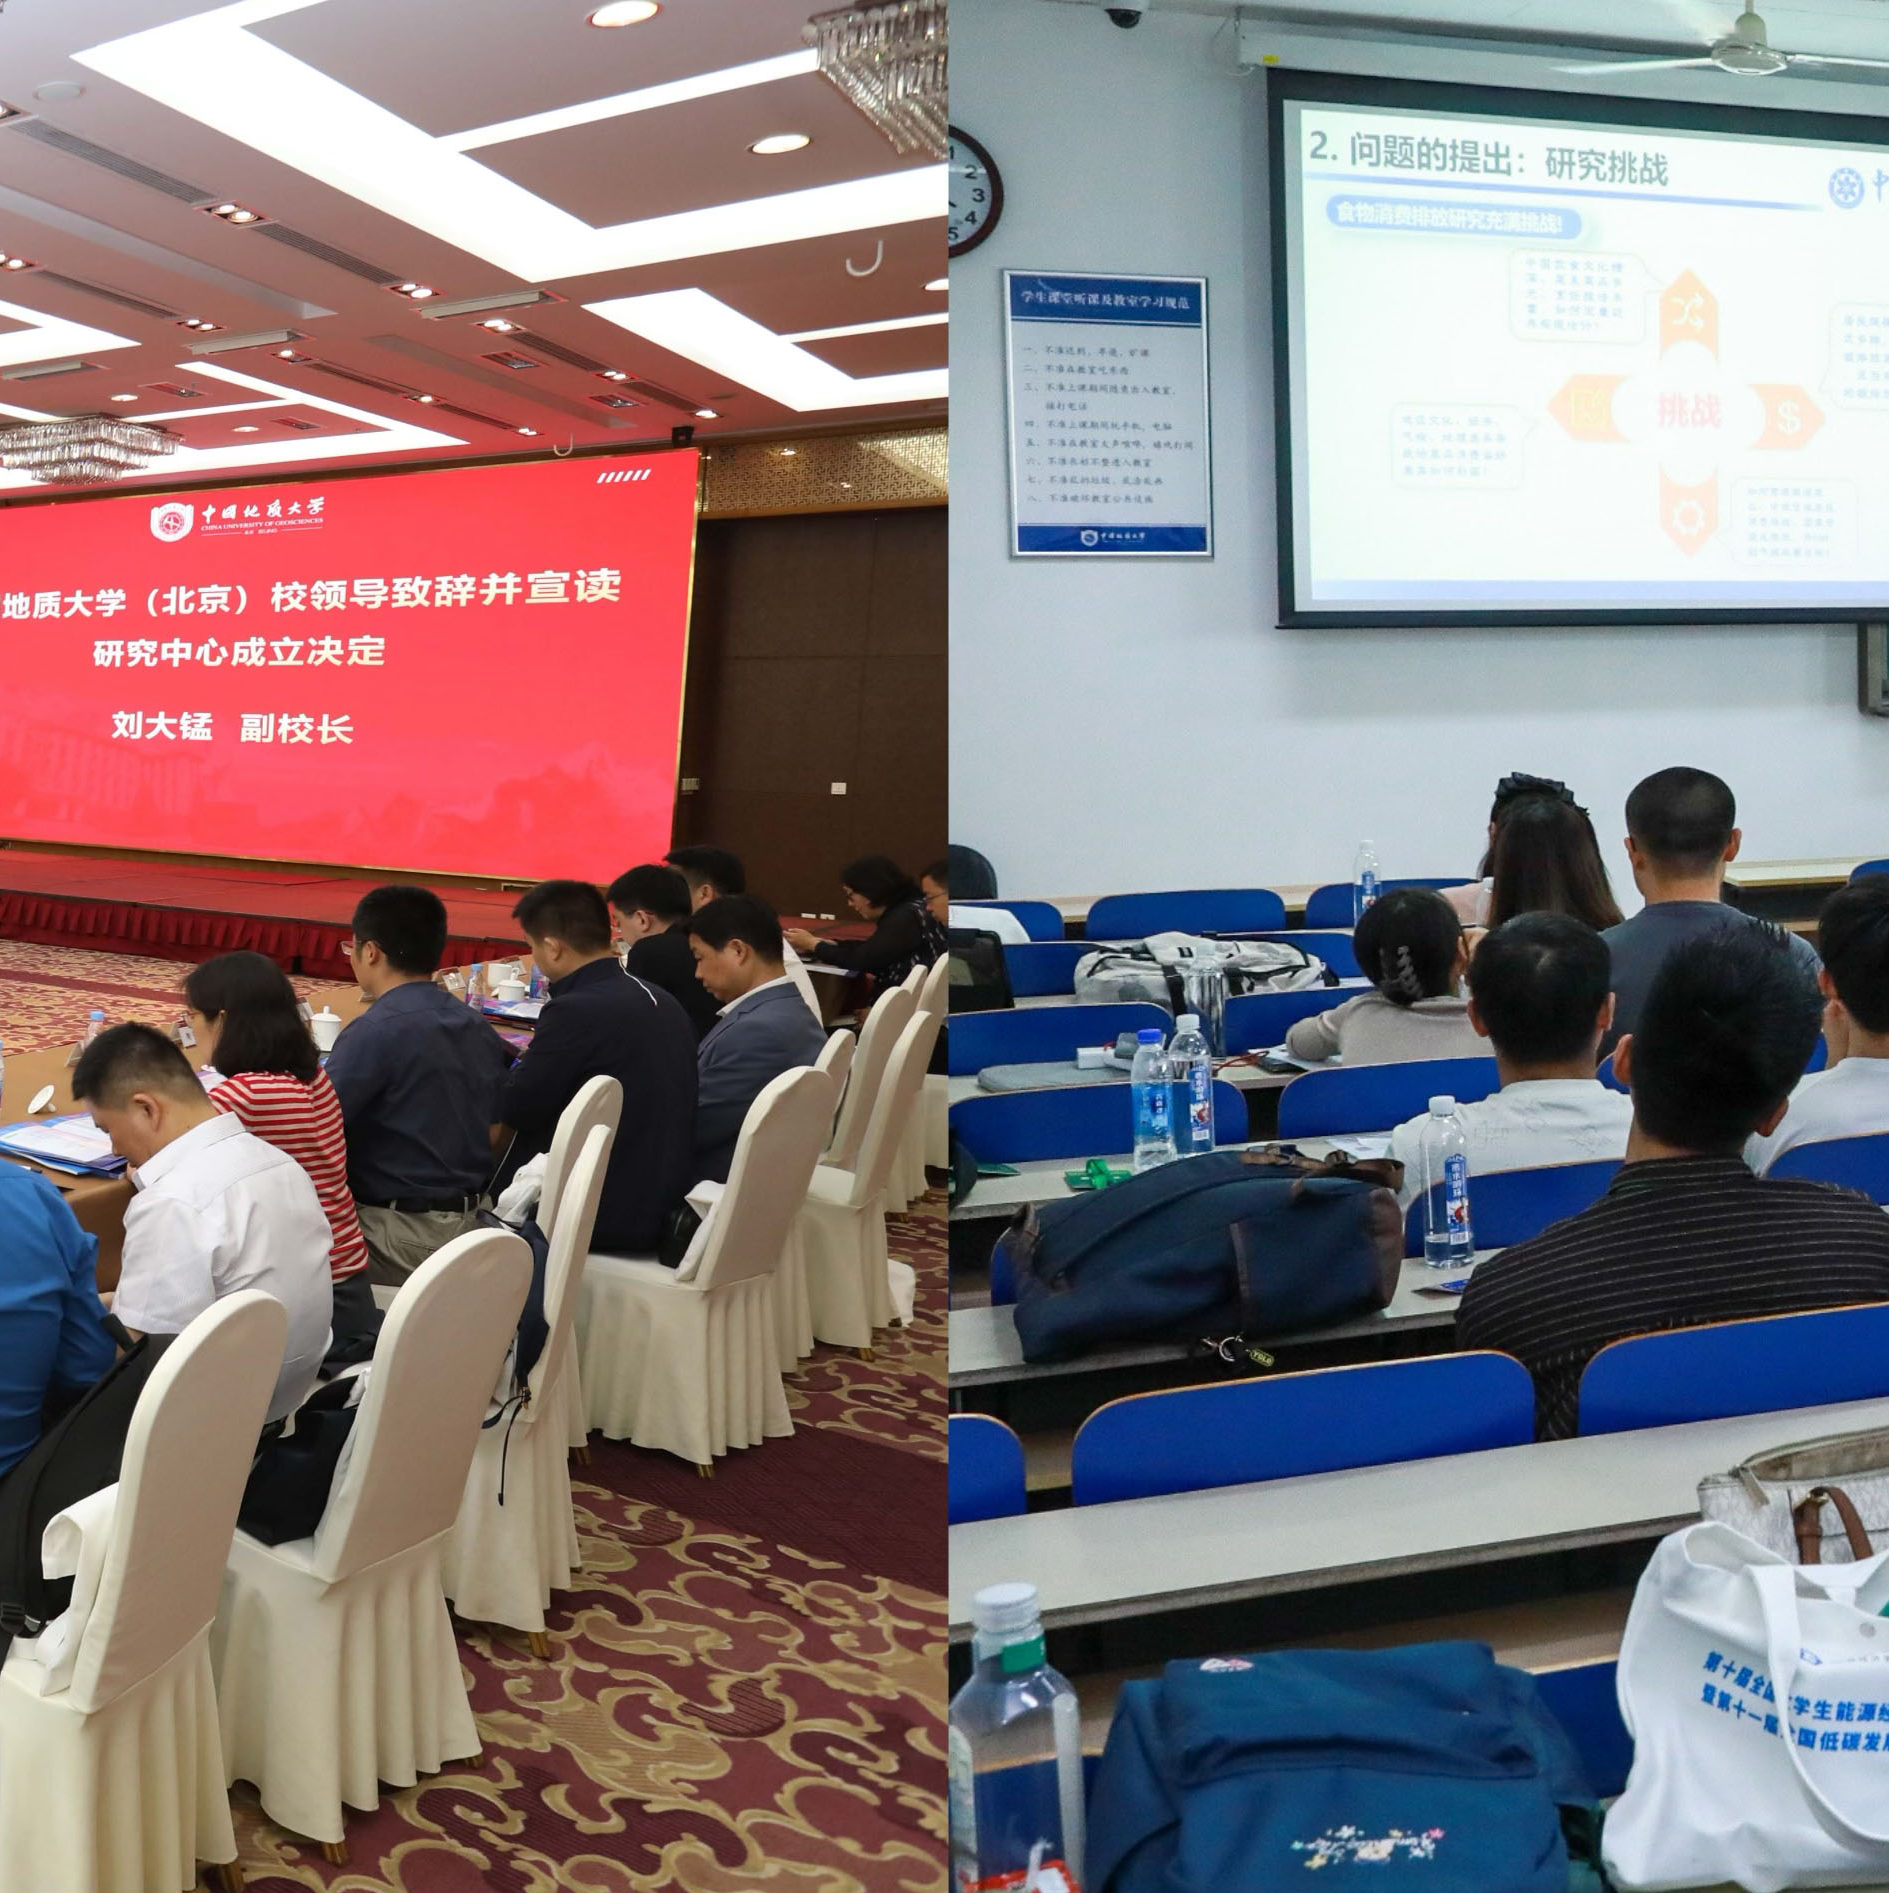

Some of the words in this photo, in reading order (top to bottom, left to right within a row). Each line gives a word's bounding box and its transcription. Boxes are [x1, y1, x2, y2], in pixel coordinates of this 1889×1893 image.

[964, 164, 978, 179] 2
[1310, 130, 1338, 161] 2.
[1350, 131, 1669, 186] 问题的提出：研究挑战
[973, 188, 985, 203] 3
[964, 211, 978, 225] 4
[1657, 392, 1721, 429] 挑战
[201, 496, 325, 524] 中国地质大学
[223, 521, 263, 530] UNIVERSITY
[92, 635, 386, 669] 研究中心成立决定
[112, 710, 214, 742] 刘大锰
[240, 712, 354, 746] 副校长
